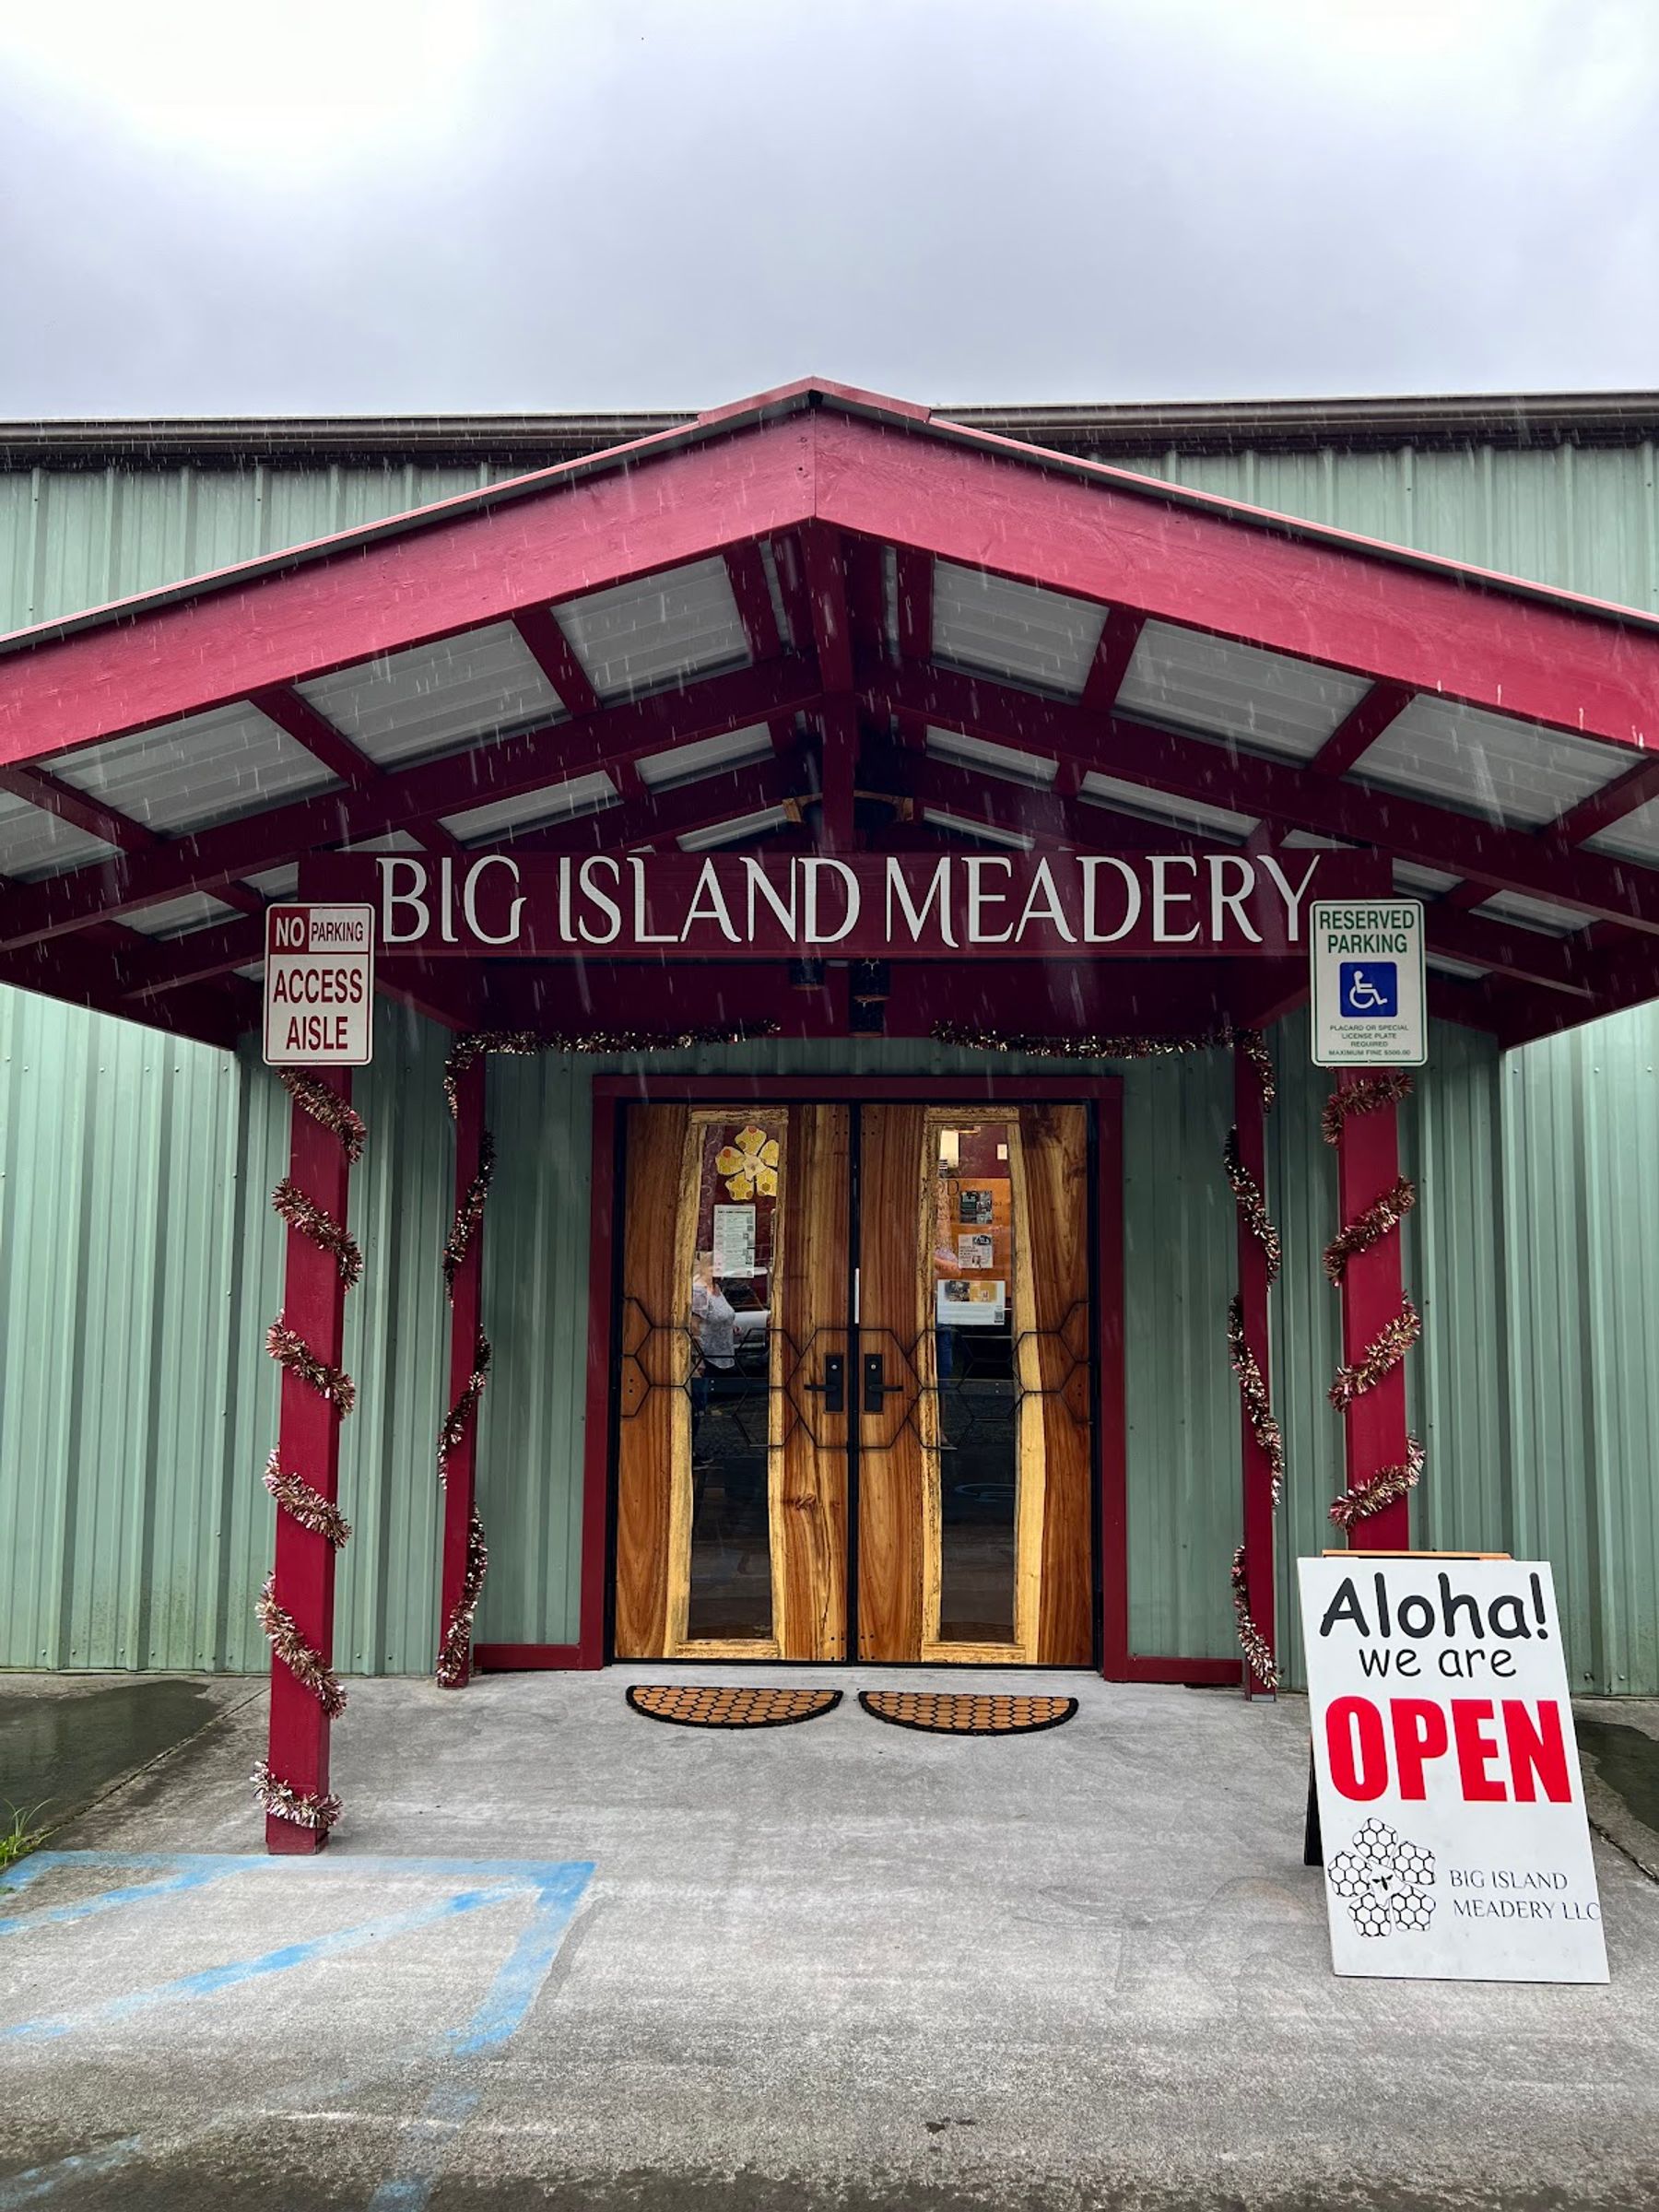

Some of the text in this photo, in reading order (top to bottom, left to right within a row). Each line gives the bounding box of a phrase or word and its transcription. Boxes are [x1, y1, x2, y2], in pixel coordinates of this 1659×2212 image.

[376, 853, 1321, 948] BIG ISLAND MEADERY
[276, 916, 363, 947] NO PARKING
[1320, 910, 1415, 930] RESERVED
[1327, 934, 1407, 954] PARKING
[273, 969, 363, 1004] ACCESS
[286, 1015, 348, 1051] AISLE
[1319, 1571, 1549, 1640] Aloha!
[1359, 1648, 1517, 1677] we are
[1325, 1695, 1572, 1804] OPEN
[1449, 1869, 1569, 1890] BIG ISLAND
[1453, 1899, 1601, 1921] MEADERY LLC
